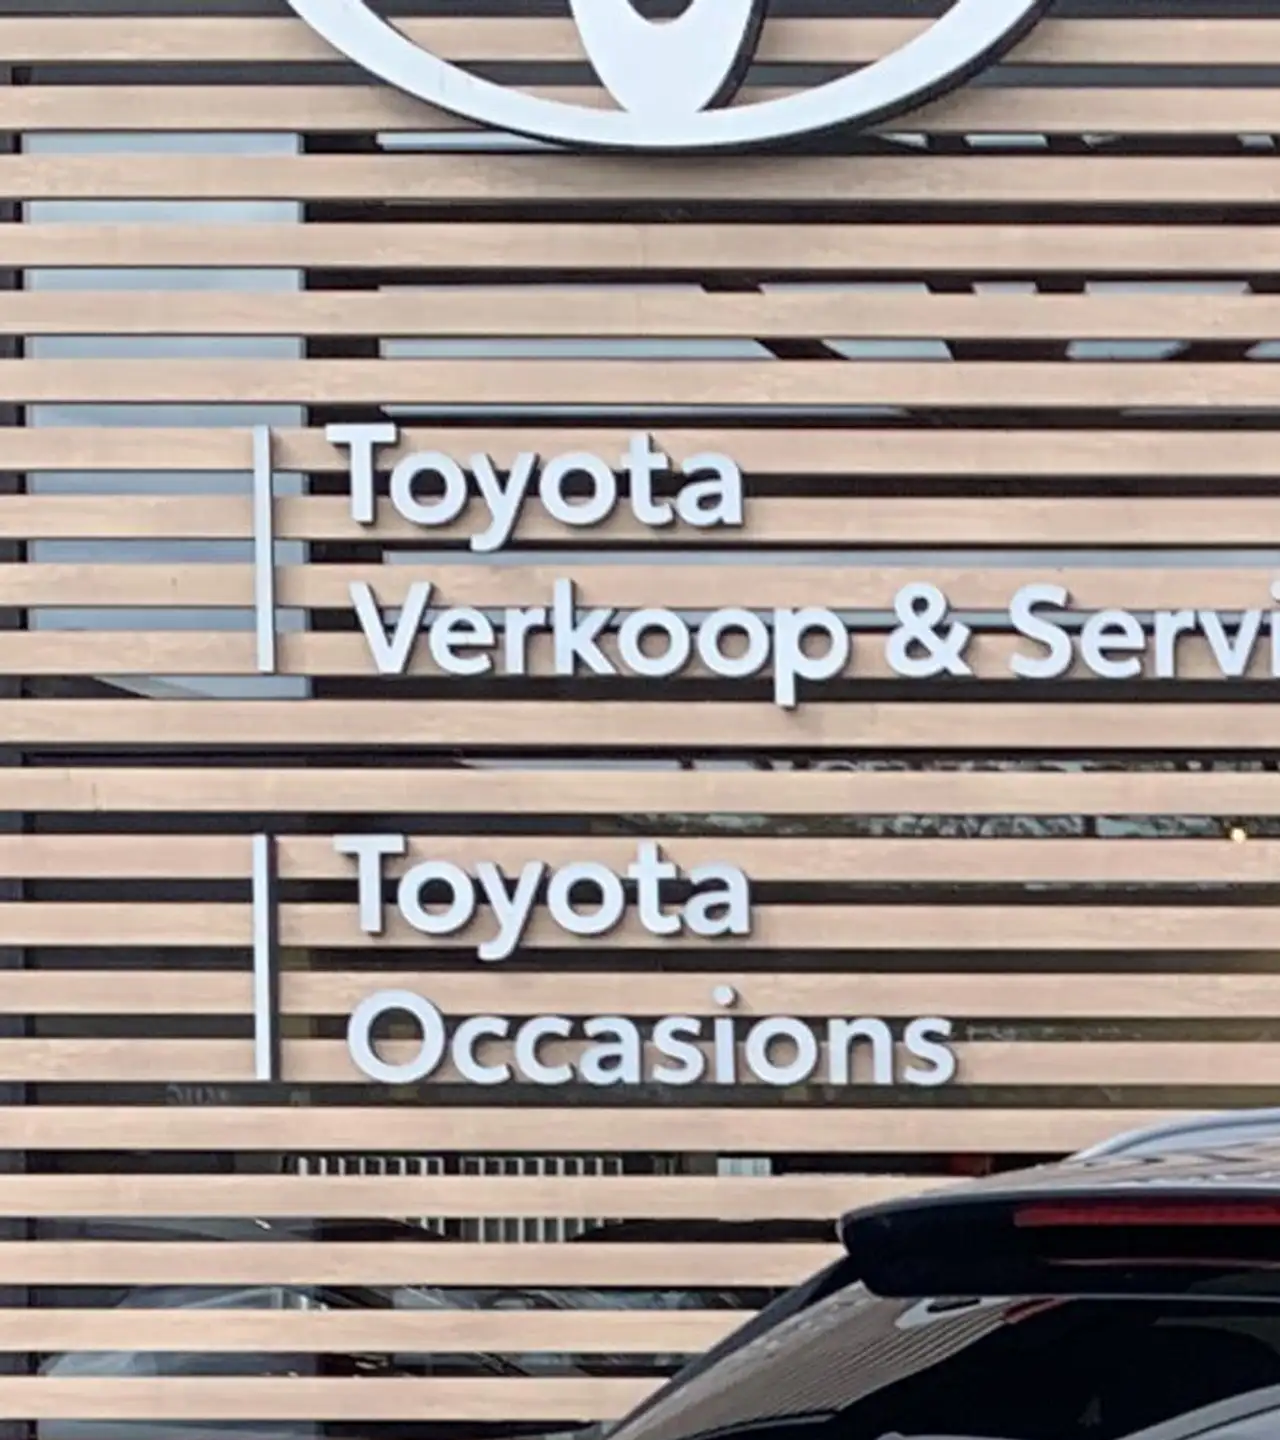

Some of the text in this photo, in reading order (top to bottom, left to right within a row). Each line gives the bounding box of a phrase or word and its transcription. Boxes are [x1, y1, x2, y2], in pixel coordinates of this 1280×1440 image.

[325, 422, 745, 552] Toyota
[349, 577, 849, 708] Verkoop
[884, 582, 972, 678] &
[335, 834, 752, 962] Toyota
[346, 985, 956, 1088] Occasions
